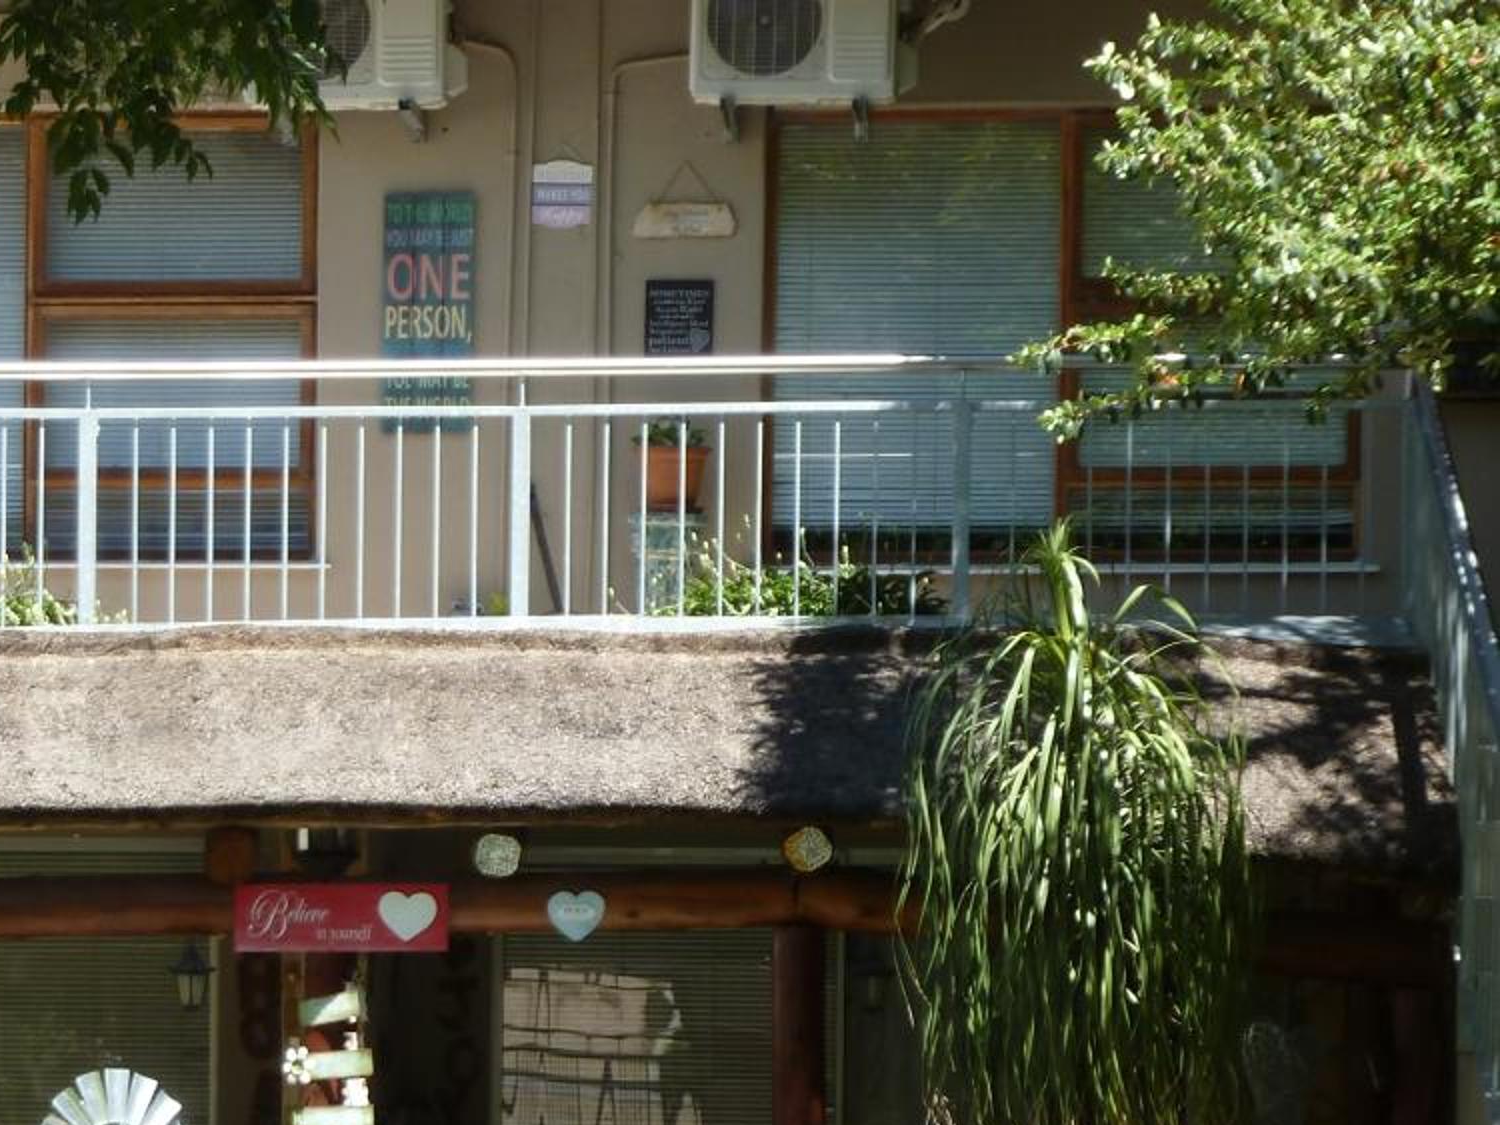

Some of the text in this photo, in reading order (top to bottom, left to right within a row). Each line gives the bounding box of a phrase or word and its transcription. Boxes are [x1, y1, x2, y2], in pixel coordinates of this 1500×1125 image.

[387, 254, 470, 300] ONE
[385, 305, 473, 343] PERSON,
[248, 889, 330, 940] Believe
